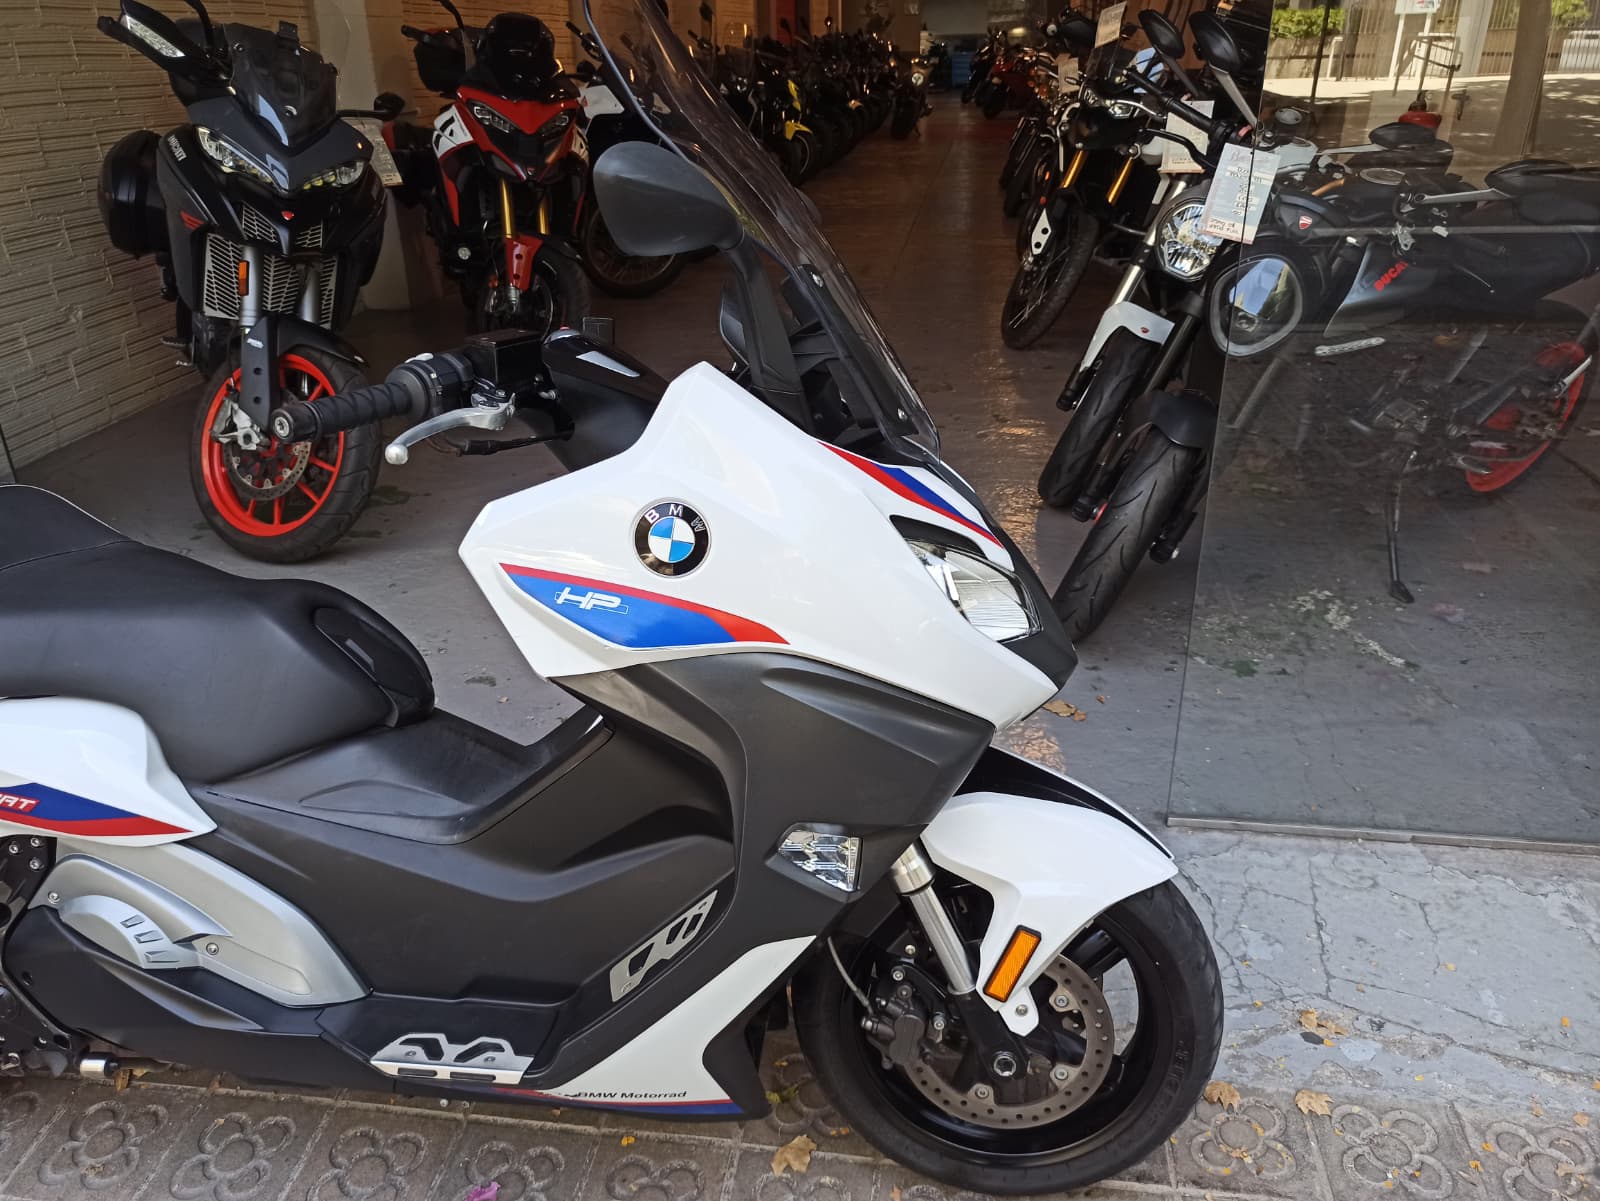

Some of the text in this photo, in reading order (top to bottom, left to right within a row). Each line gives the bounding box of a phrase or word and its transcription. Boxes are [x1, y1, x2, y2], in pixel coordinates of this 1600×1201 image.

[644, 504, 706, 532] BMW
[556, 586, 622, 611] HP
[577, 1090, 688, 1099] BMW Motorrad
